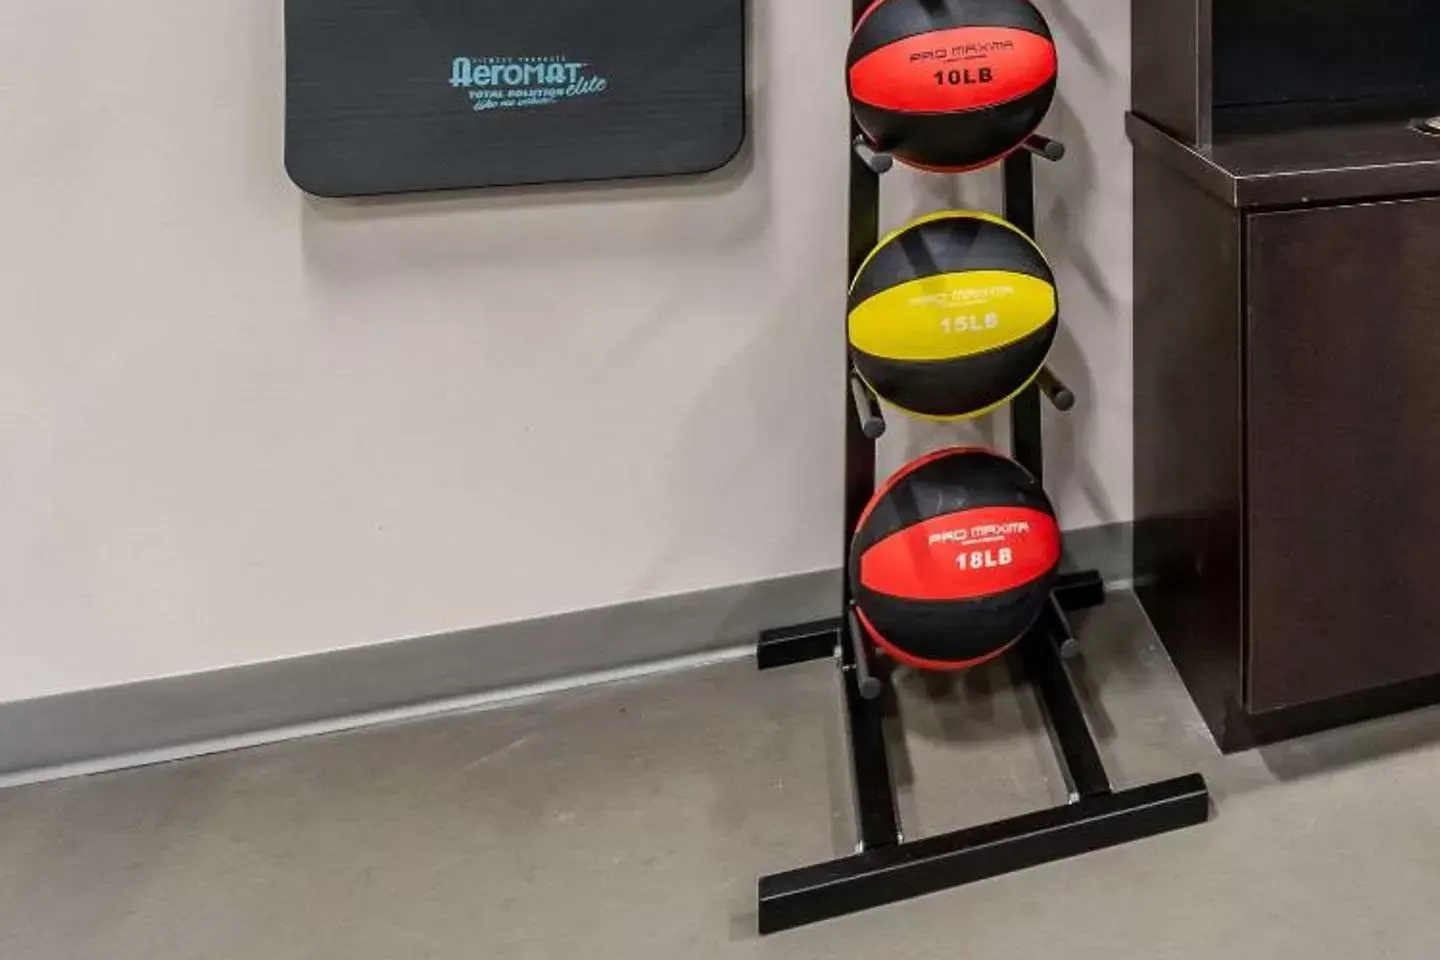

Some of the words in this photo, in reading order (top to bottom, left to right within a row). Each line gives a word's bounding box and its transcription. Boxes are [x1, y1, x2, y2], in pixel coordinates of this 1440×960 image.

[910, 49, 947, 63] PRO
[951, 40, 1014, 56] MAXIMA
[934, 67, 993, 85] 10LB
[940, 311, 999, 334] 15LB
[928, 529, 968, 546] PRO
[970, 521, 1030, 538] MAXIMA
[956, 547, 1012, 570] 18LB
